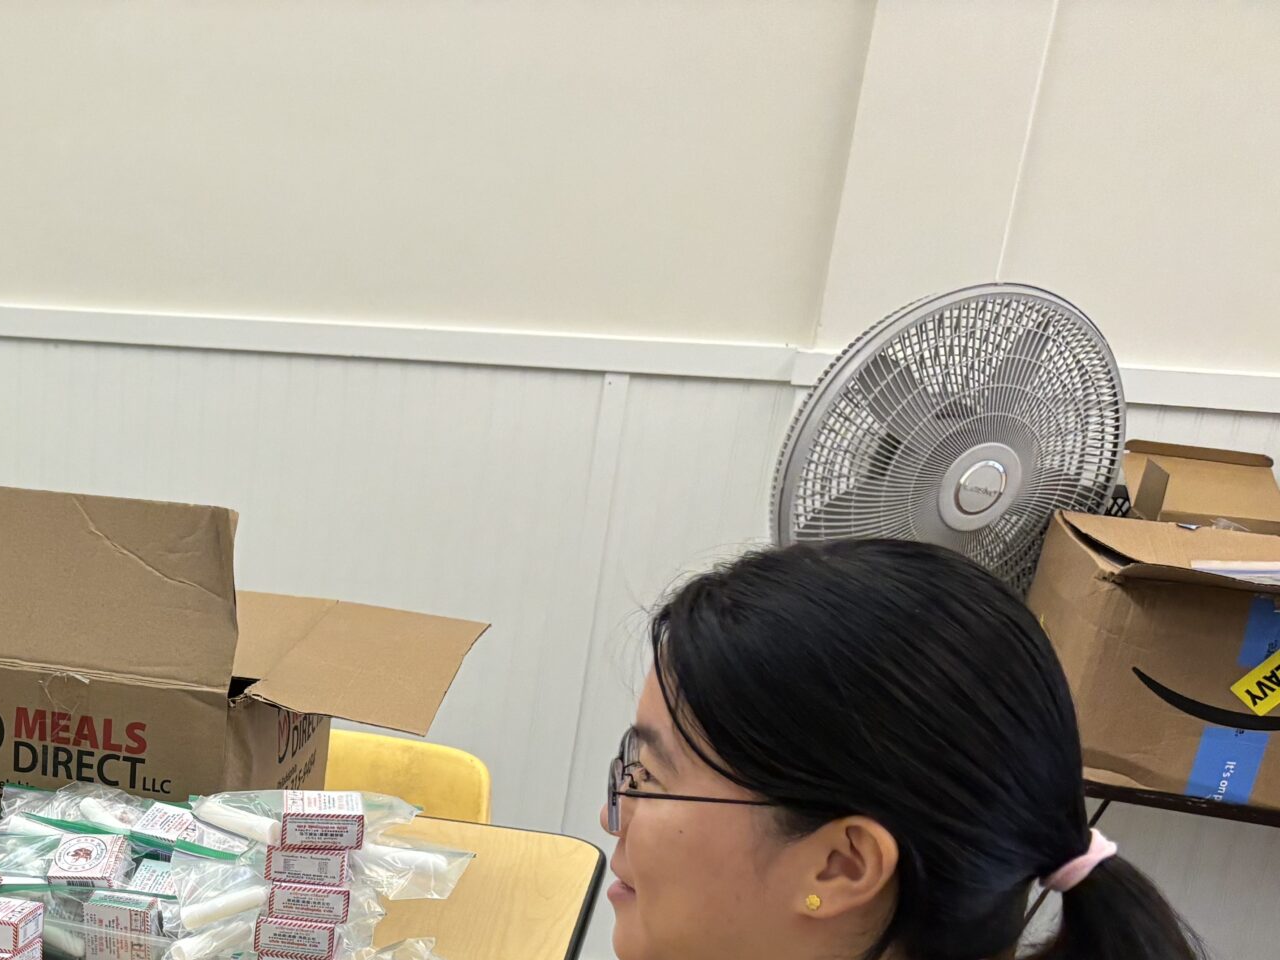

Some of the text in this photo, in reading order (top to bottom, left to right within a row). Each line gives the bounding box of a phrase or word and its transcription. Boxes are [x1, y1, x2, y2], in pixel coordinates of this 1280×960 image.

[1244, 664, 1280, 707] AVY
[13, 706, 148, 755] MEALS
[12, 740, 172, 794] DIRECT LLC
